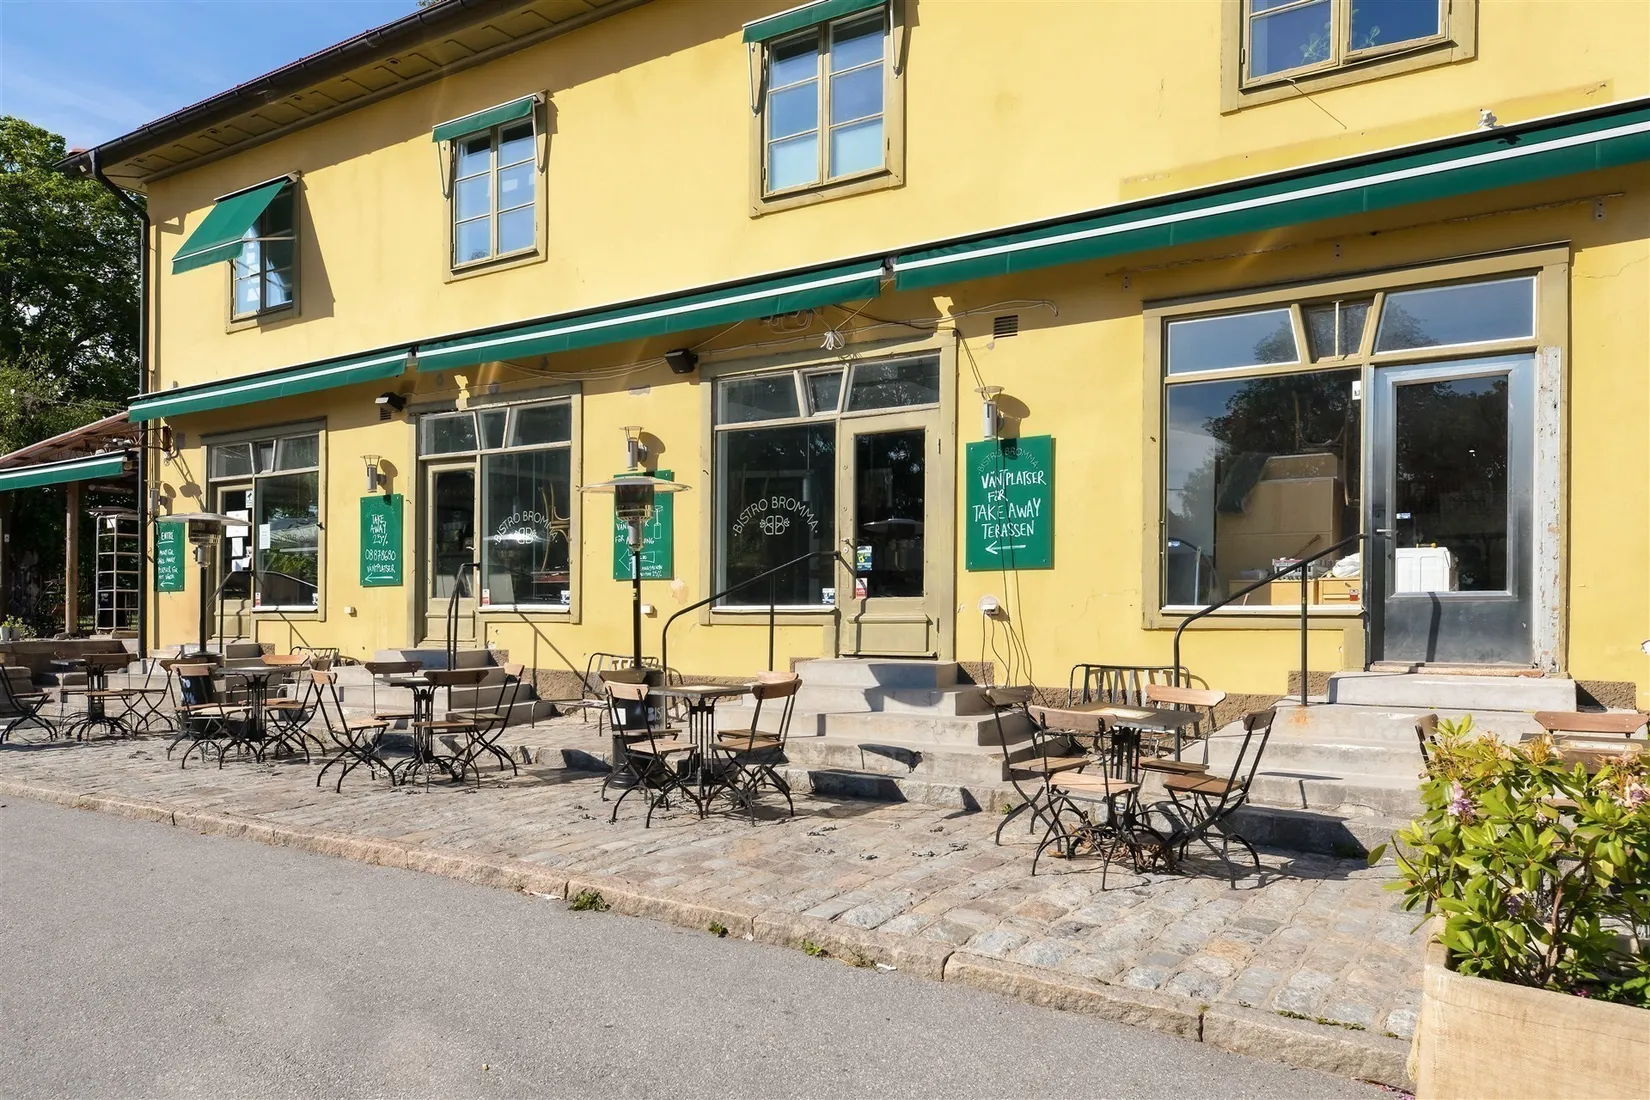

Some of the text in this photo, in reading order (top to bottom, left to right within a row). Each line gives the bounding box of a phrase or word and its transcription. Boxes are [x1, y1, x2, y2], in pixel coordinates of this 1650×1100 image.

[732, 496, 819, 534] BISTRO BROMMA
[972, 497, 1041, 522] TAKE AWAY
[494, 512, 521, 543] BISTRO
[981, 520, 1034, 539] TERASSEN
